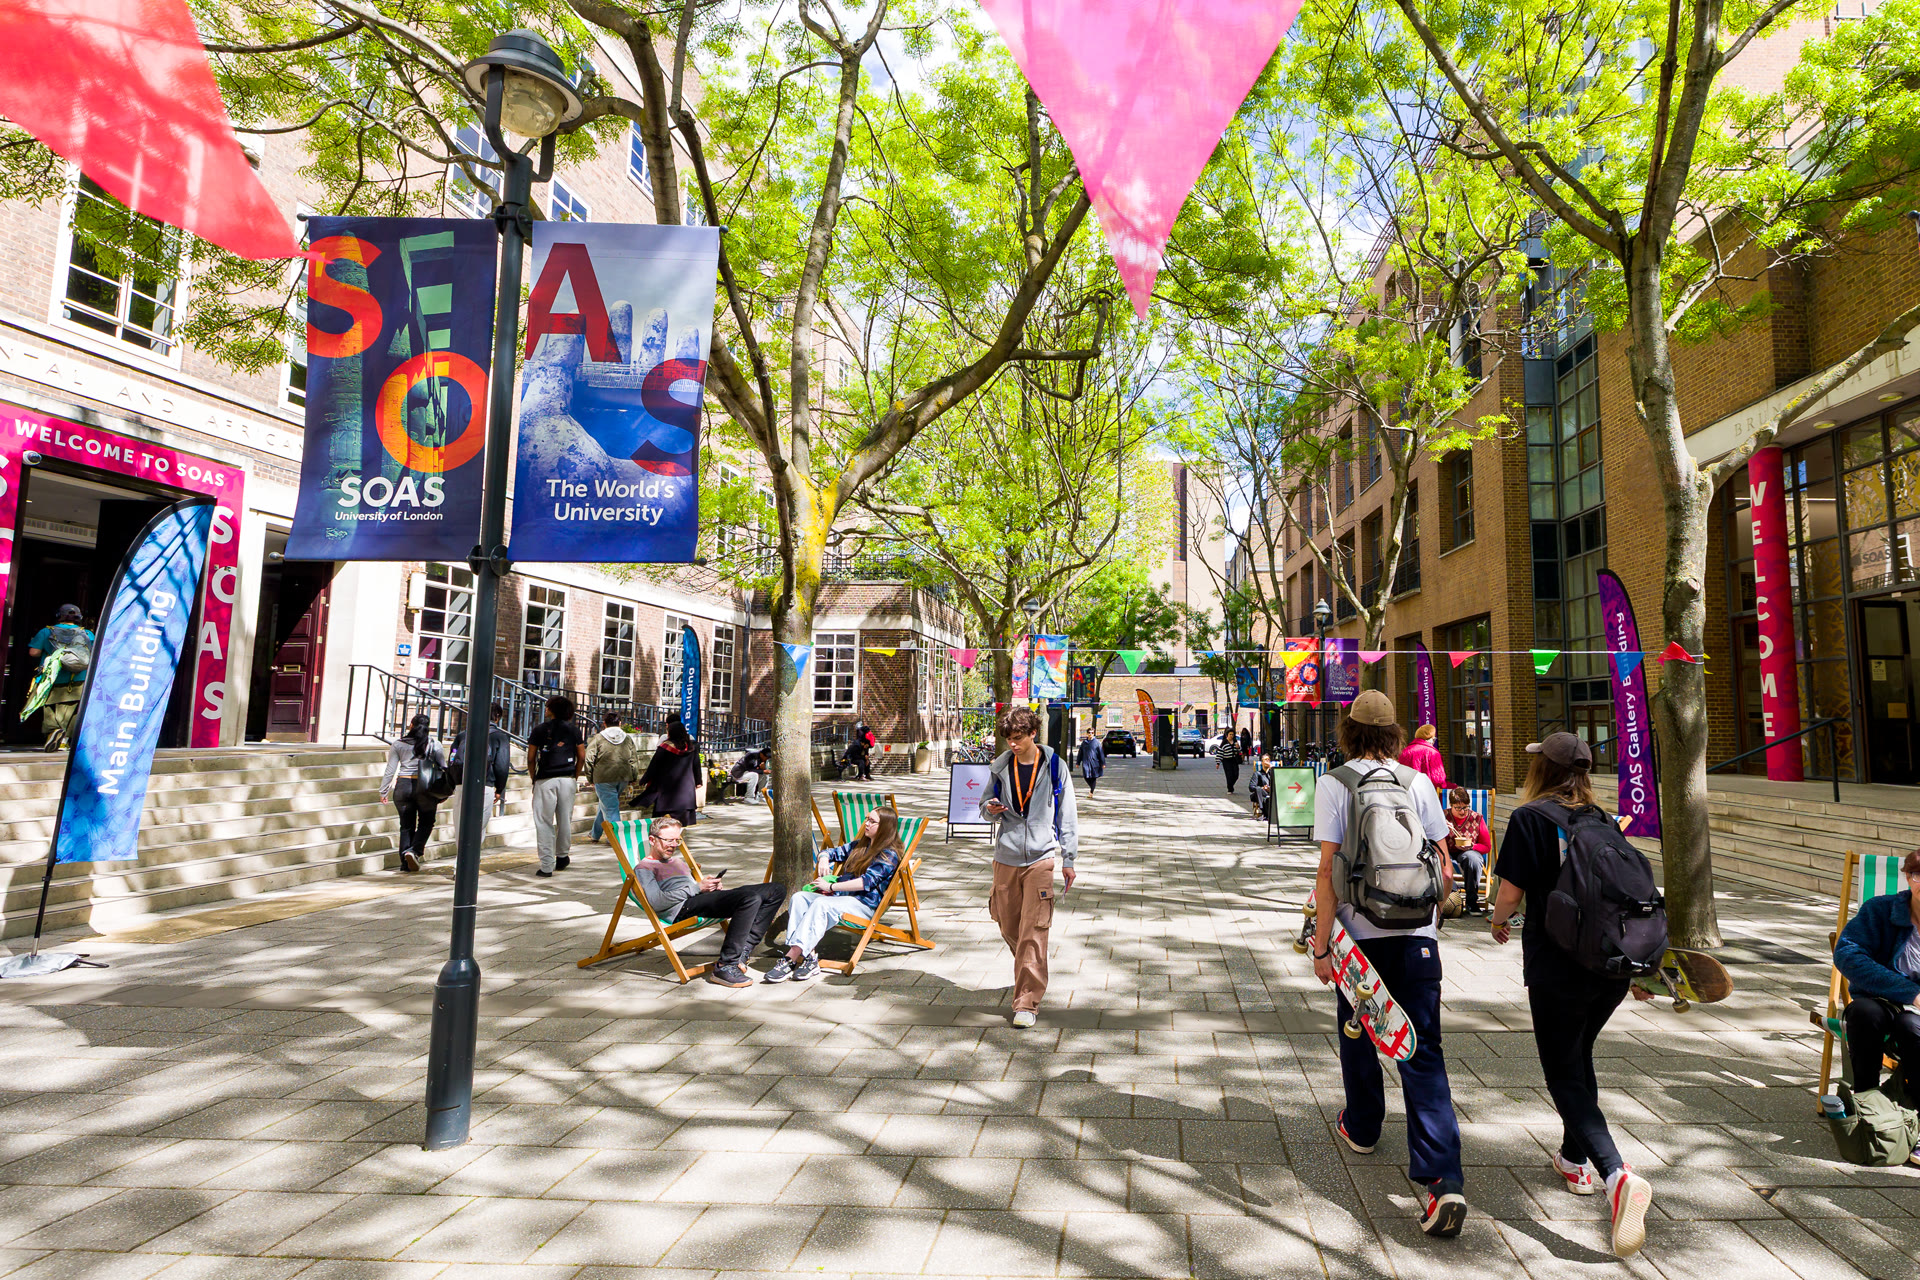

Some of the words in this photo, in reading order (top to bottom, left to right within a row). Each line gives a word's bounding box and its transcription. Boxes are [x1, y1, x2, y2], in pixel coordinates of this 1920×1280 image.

[525, 242, 623, 363] A
[375, 351, 489, 473] O
[14, 418, 135, 465] WELCOME
[141, 452, 170, 472] TO
[176, 463, 225, 487] SOAS
[335, 511, 390, 523] University
[389, 511, 403, 521] of
[403, 511, 443, 521] London
[337, 476, 446, 508] SOAS
[546, 479, 588, 498] The
[594, 479, 675, 499] World's
[554, 502, 664, 526] University
[1862, 549, 1892, 564] SOAS
[200, 506, 238, 720] SOAS
[1617, 611, 1632, 687] Building
[97, 721, 137, 795] Main
[120, 589, 176, 712] Building
[1293, 685, 1314, 693] SOAS
[1625, 692, 1640, 759] Gallery
[1628, 762, 1645, 815] SOAS
